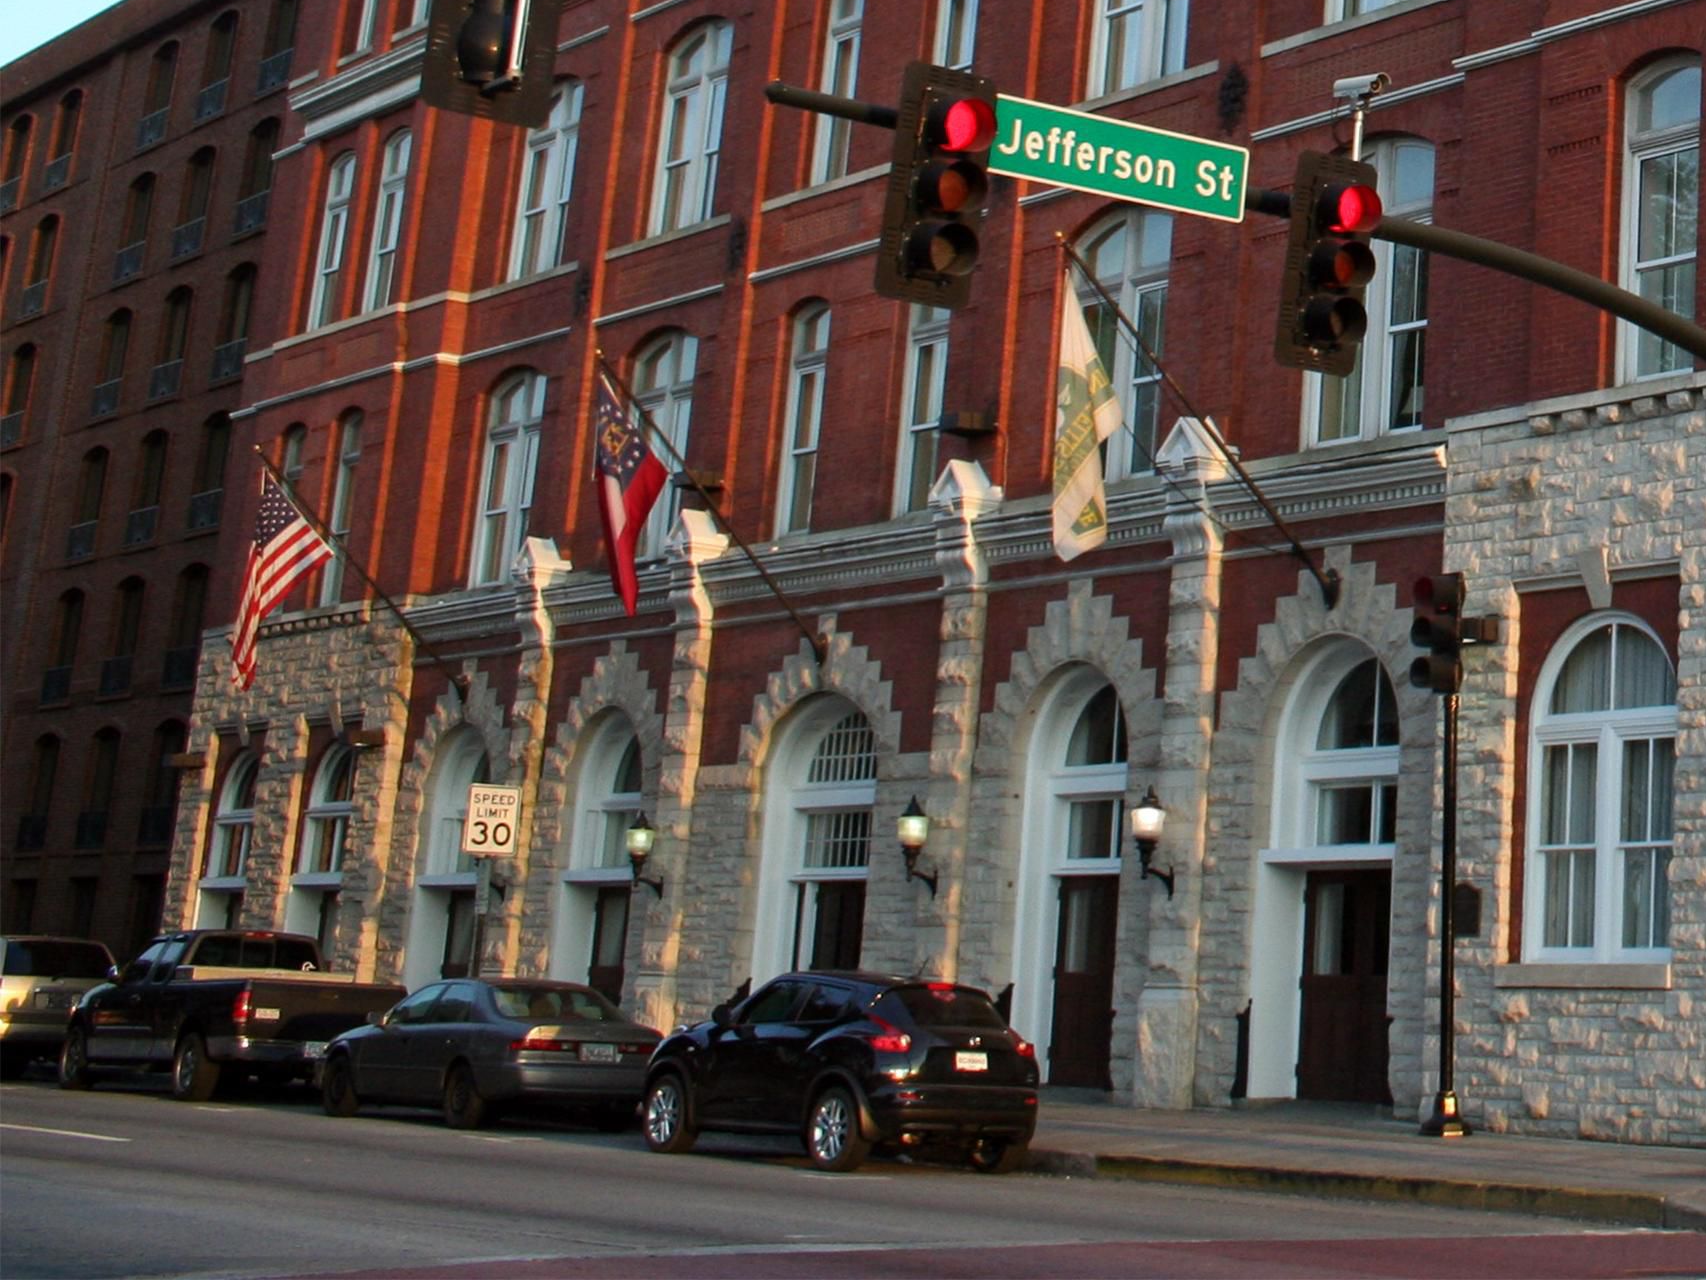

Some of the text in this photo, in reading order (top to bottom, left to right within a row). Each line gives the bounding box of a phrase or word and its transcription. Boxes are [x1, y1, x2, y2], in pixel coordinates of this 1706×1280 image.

[998, 118, 1234, 201] Jefferson St
[474, 793, 515, 805] SPEED
[477, 808, 509, 818] LIMIT
[471, 821, 511, 846] 30
